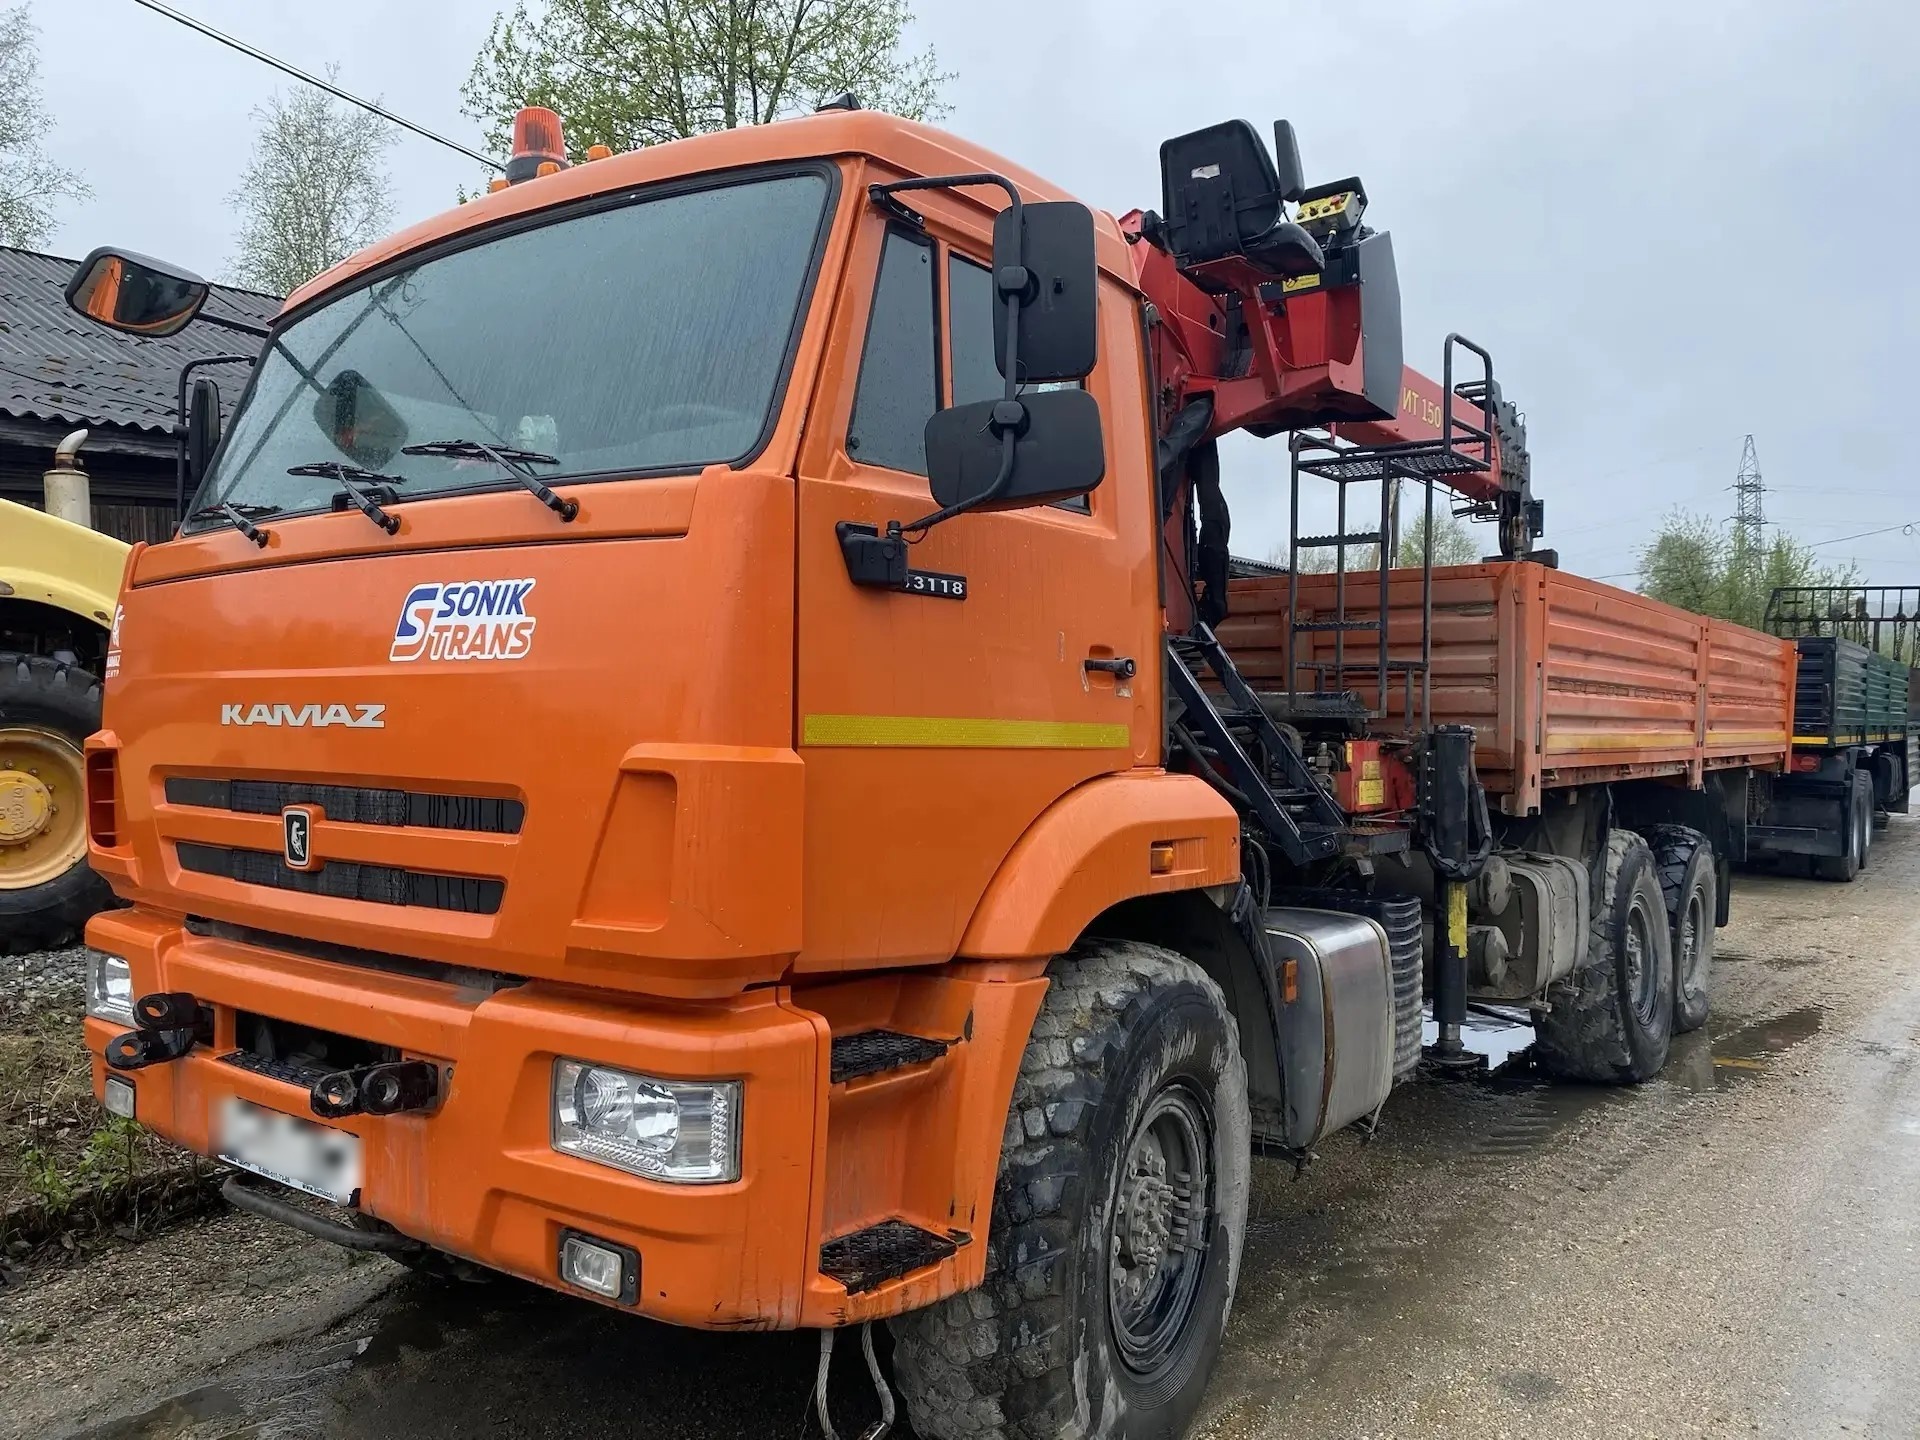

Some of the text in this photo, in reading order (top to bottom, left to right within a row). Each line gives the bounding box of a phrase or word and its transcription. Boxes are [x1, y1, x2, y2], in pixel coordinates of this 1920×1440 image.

[1422, 398, 1441, 429] 150
[437, 582, 534, 618] SONIK
[906, 576, 963, 595] 3118
[431, 621, 535, 658] TRANS
[221, 704, 386, 728] KAMAZ
